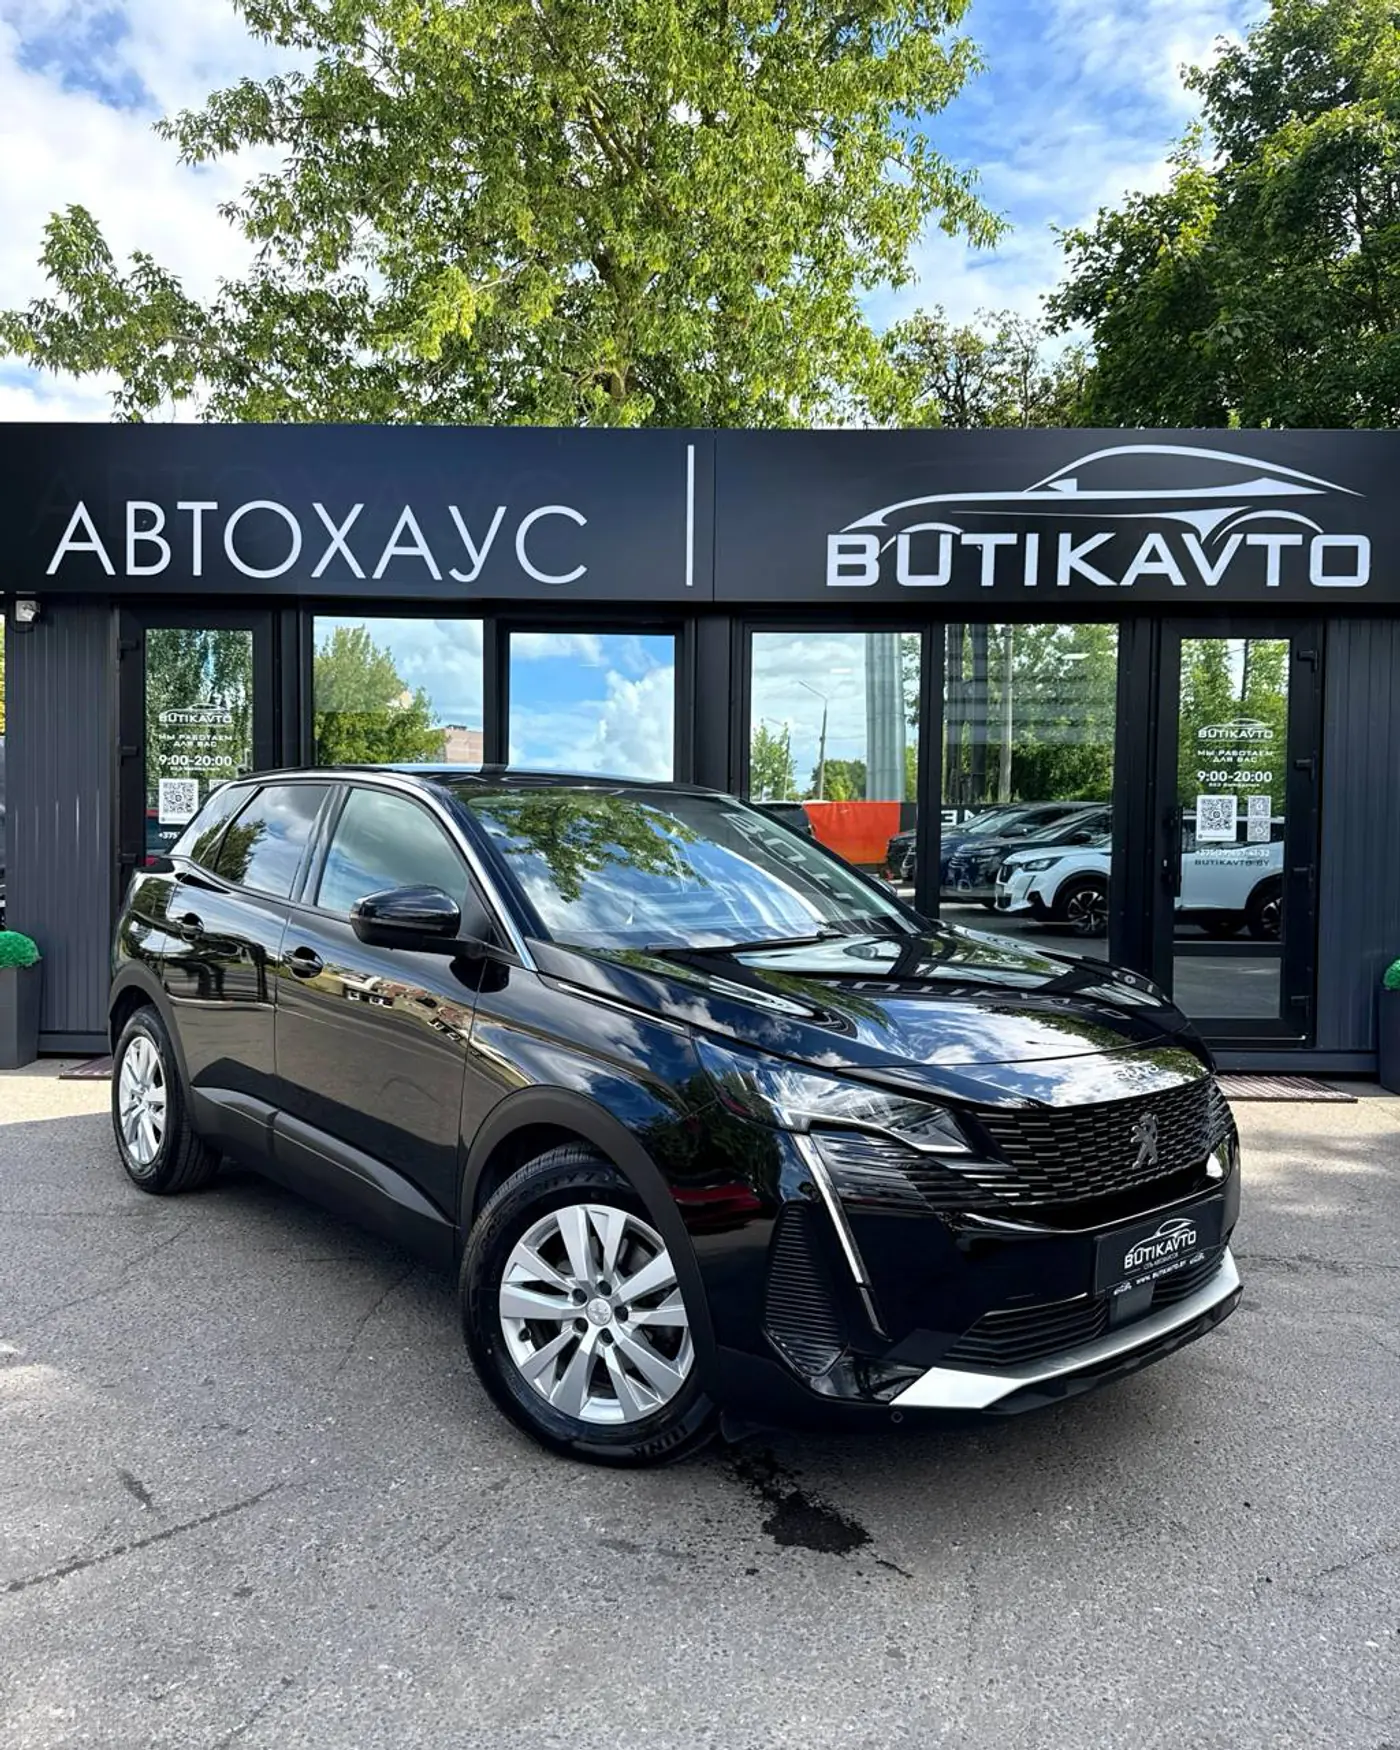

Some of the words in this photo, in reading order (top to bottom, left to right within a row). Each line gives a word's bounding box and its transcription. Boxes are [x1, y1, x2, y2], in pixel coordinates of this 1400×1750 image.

[46, 500, 588, 585] АВТОХАУС
[826, 533, 1371, 587] BUTIKAVTO
[1197, 729, 1274, 739] BUTIKAVTO
[158, 754, 233, 767] 9:00-20:00
[1197, 770, 1273, 783] 9:00-20:00
[1124, 1230, 1197, 1269] BUTIKAVTO
